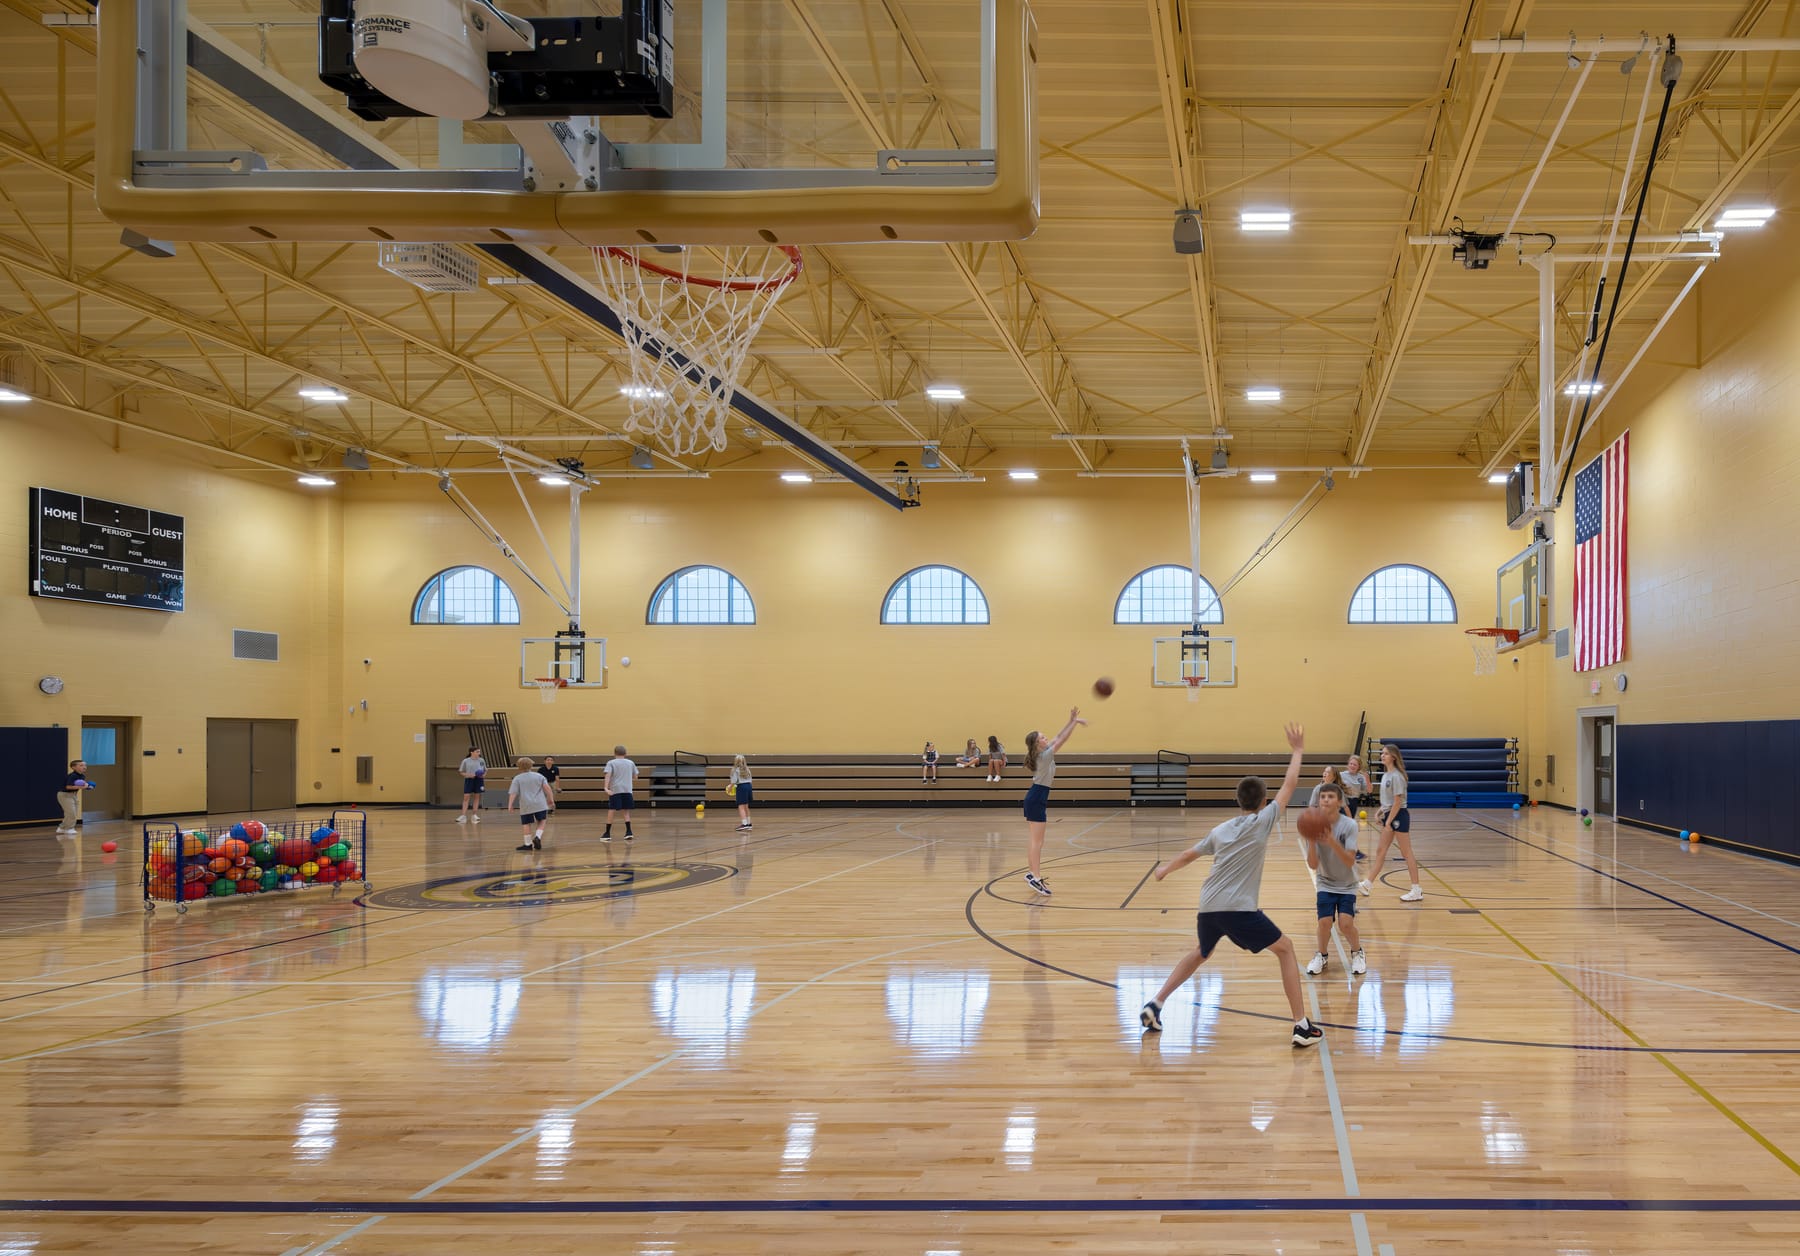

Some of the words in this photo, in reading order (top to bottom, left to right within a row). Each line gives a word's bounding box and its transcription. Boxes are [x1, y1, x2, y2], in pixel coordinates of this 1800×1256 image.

[368, 25, 403, 33] SYSTEMS
[44, 507, 77, 521] HOME
[102, 527, 132, 538] PERIOD
[152, 528, 182, 540] GUEST
[61, 545, 89, 554] BONUS
[41, 554, 67, 563] FOULS
[143, 558, 167, 567] BONUS
[103, 564, 129, 572] PLAYER
[43, 585, 63, 593] WON
